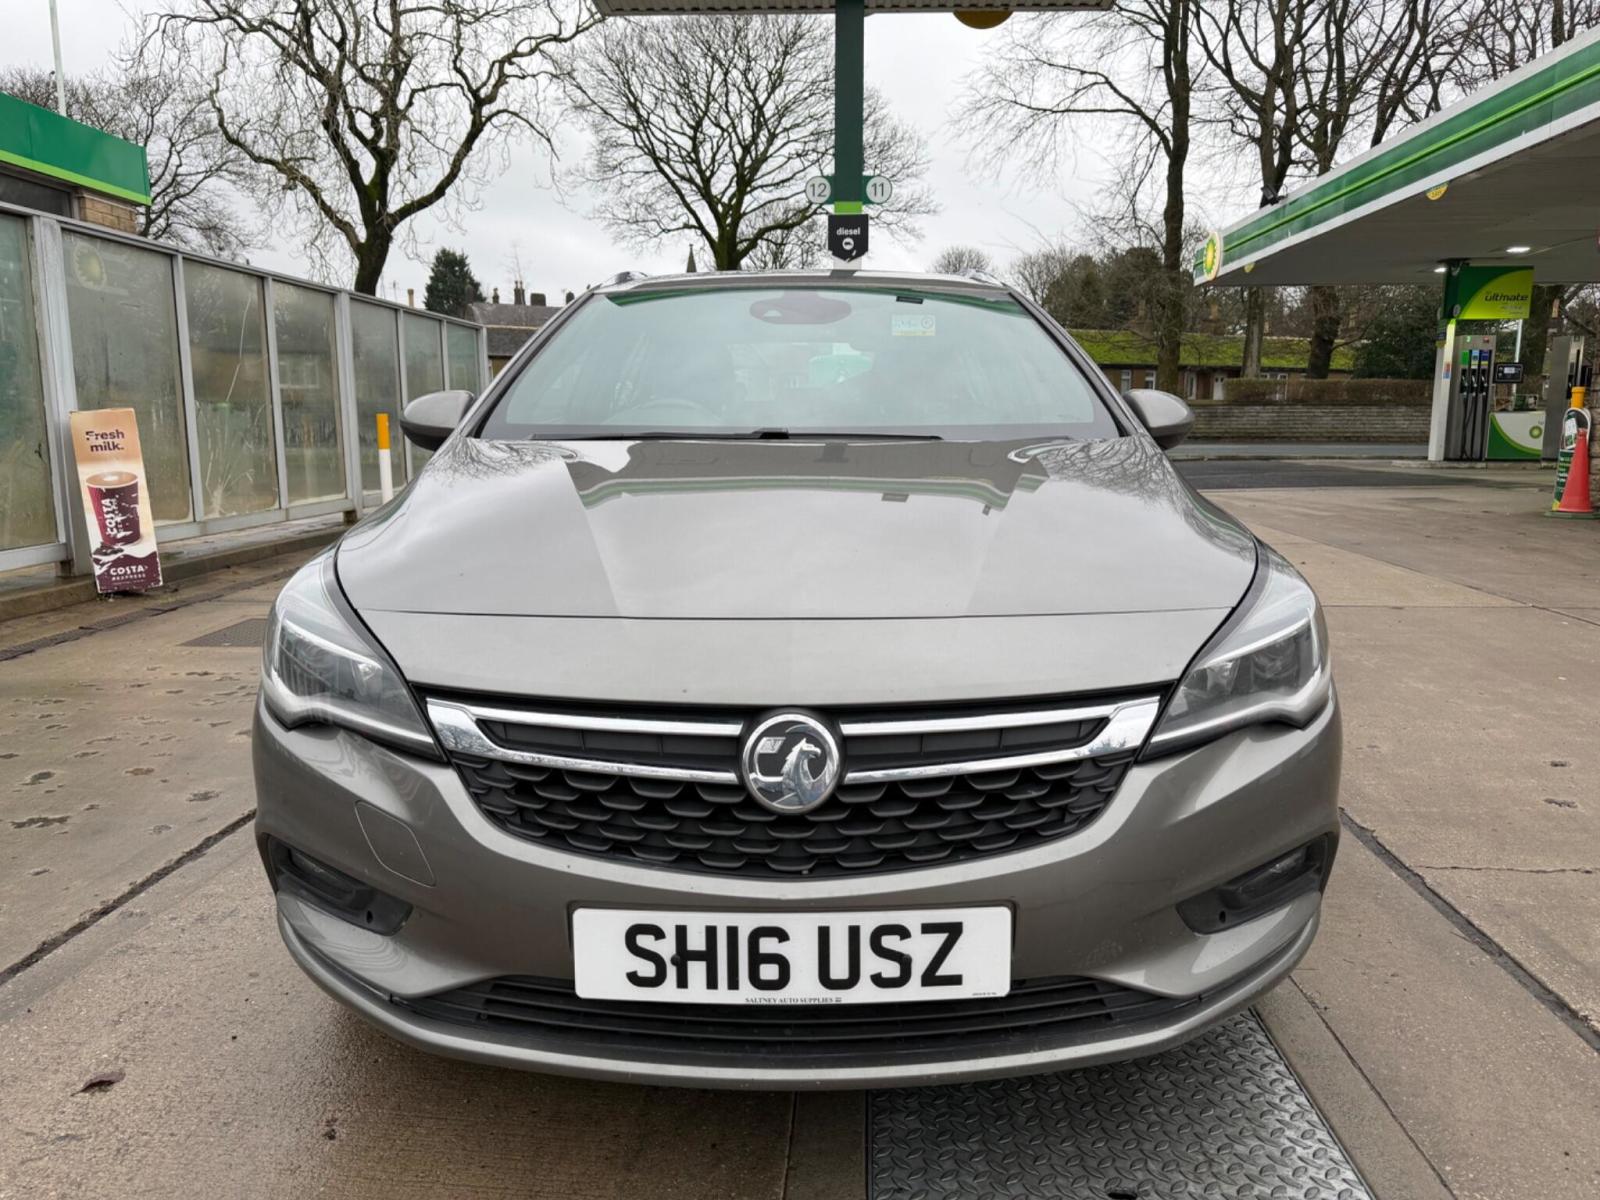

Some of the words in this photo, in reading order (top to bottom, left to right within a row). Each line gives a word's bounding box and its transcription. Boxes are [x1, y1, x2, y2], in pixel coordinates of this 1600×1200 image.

[809, 182, 827, 198] 12
[871, 182, 885, 198] 11
[836, 226, 861, 236] diesel
[1484, 291, 1529, 302] ultimate
[85, 428, 125, 441] Fresh
[90, 440, 125, 453] milk.
[101, 498, 118, 536] COSTA
[109, 564, 145, 576] COSTA
[624, 922, 791, 991] SH16
[817, 921, 964, 990] USZ
